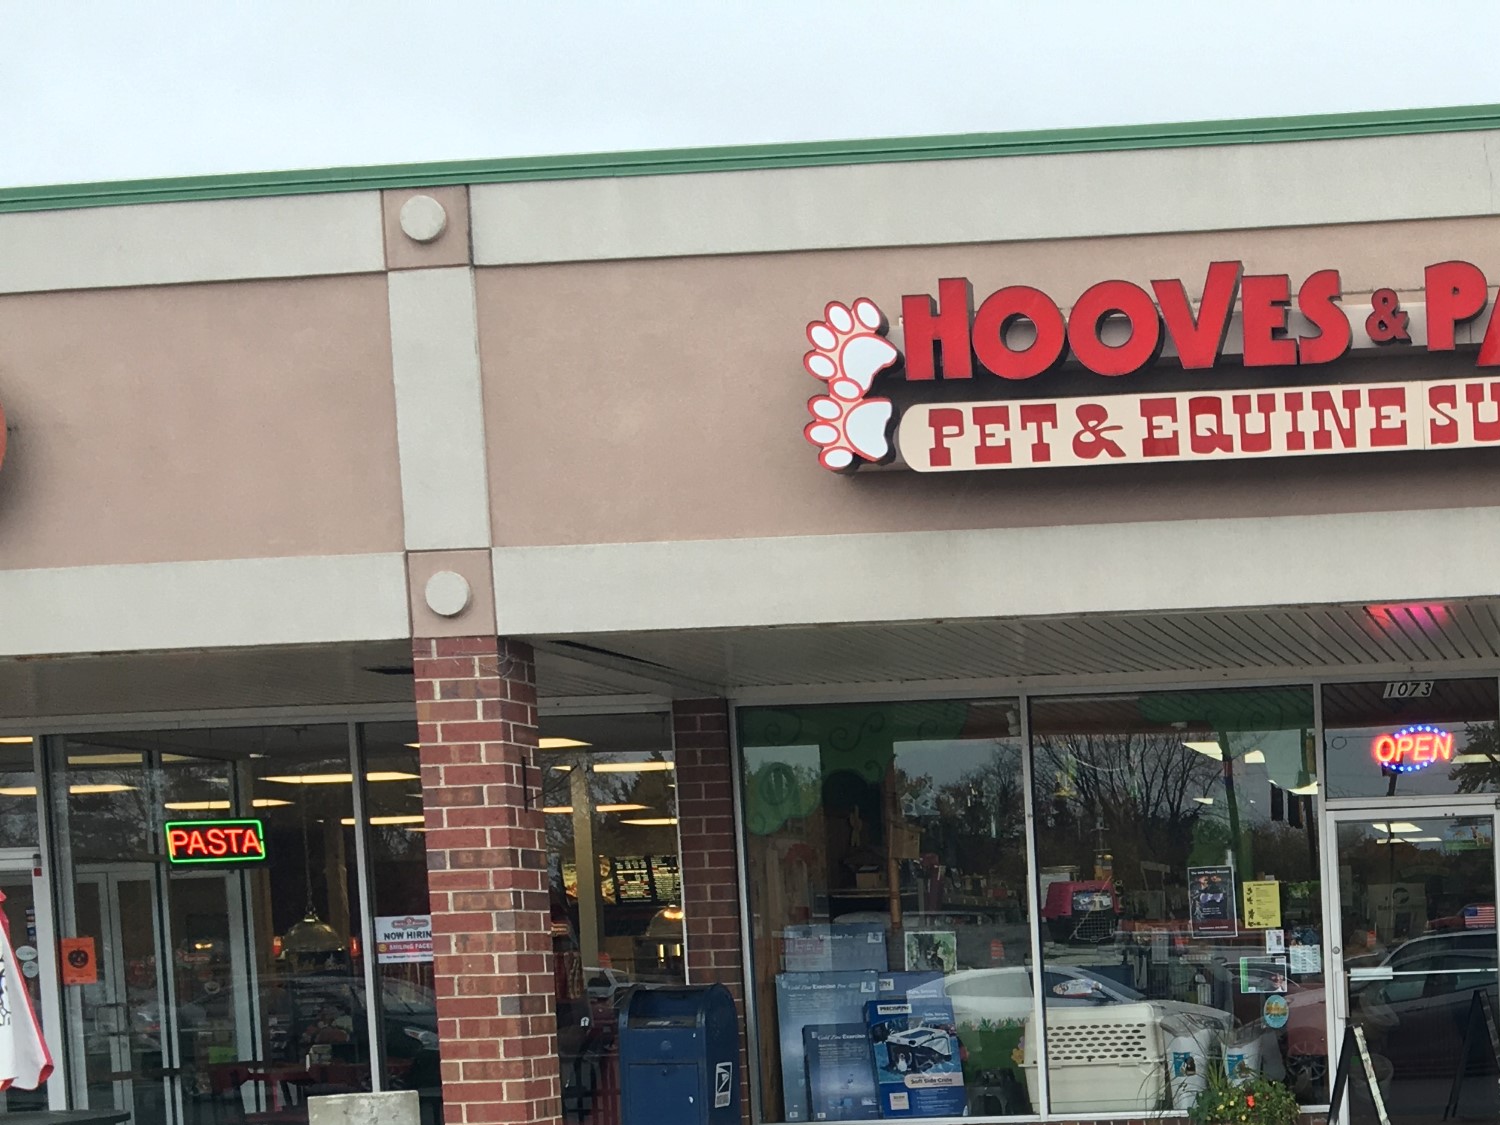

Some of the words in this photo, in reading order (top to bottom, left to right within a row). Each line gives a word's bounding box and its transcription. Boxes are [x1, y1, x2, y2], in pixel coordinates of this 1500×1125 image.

[901, 260, 1353, 382] HOOVES
[1364, 288, 1412, 345] &
[928, 406, 1057, 468] PET
[1071, 402, 1126, 460] &
[1141, 389, 1408, 458] EQUINE
[1387, 682, 1432, 697] 1073
[1374, 731, 1454, 763] OPEN
[169, 828, 263, 856] PASTA
[383, 931, 404, 941] NOW
[406, 930, 432, 940] HIRIN
